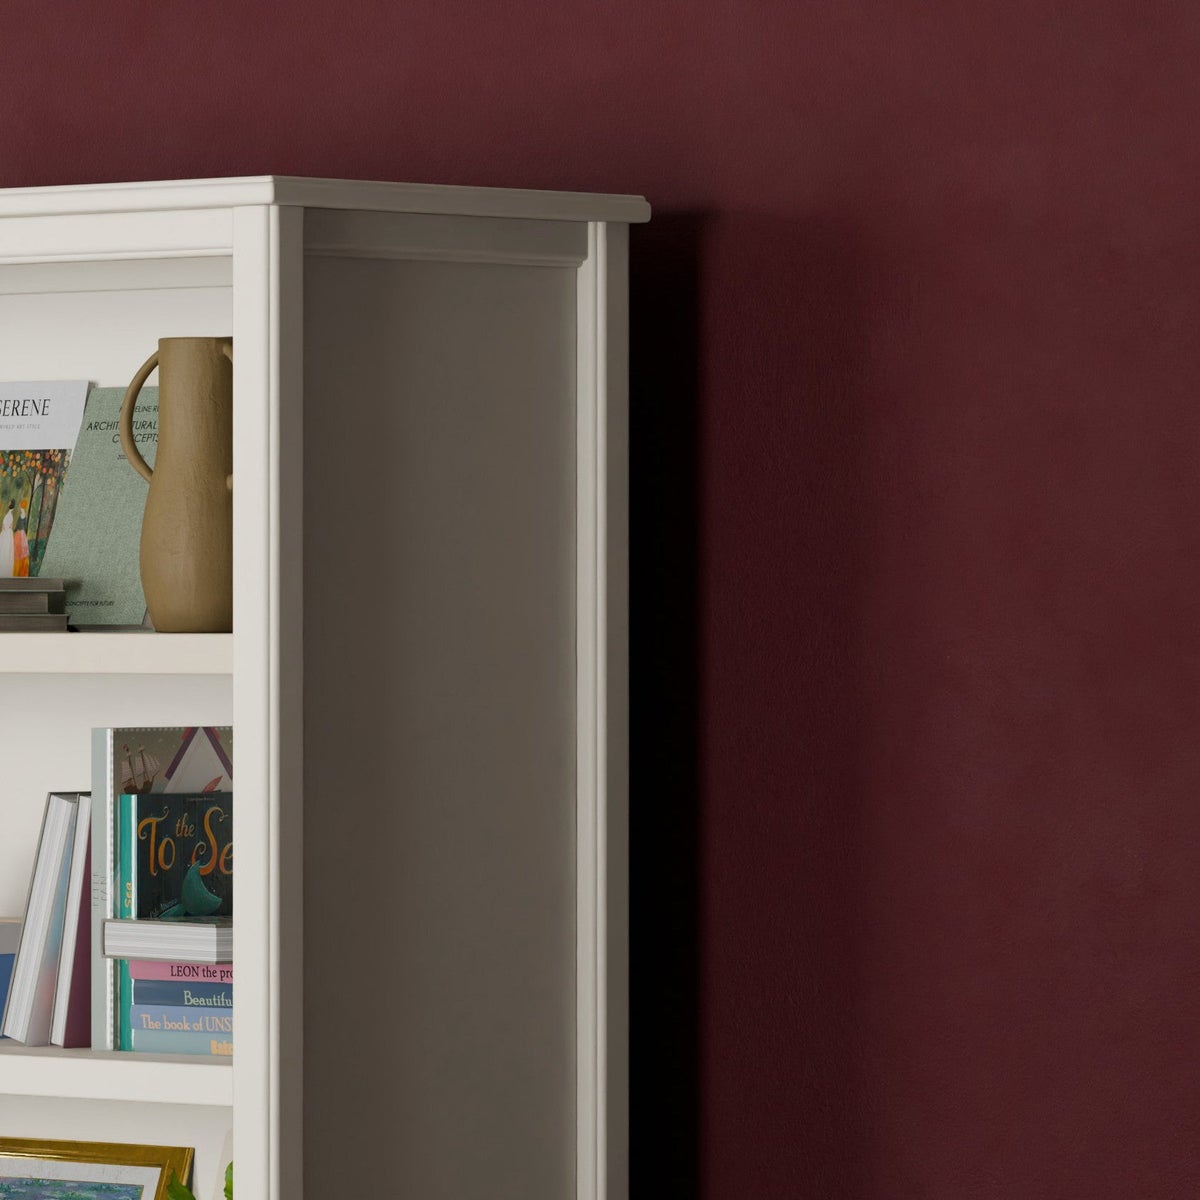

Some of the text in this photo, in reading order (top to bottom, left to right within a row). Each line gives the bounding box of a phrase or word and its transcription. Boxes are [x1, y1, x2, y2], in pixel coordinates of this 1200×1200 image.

[86, 420, 157, 431] ARCHITTURAL
[137, 806, 233, 876] To the Se
[170, 965, 200, 977] LEON
[202, 966, 217, 978] the
[183, 990, 233, 1006] Beautifu
[141, 1013, 233, 1032] The book of UNS
